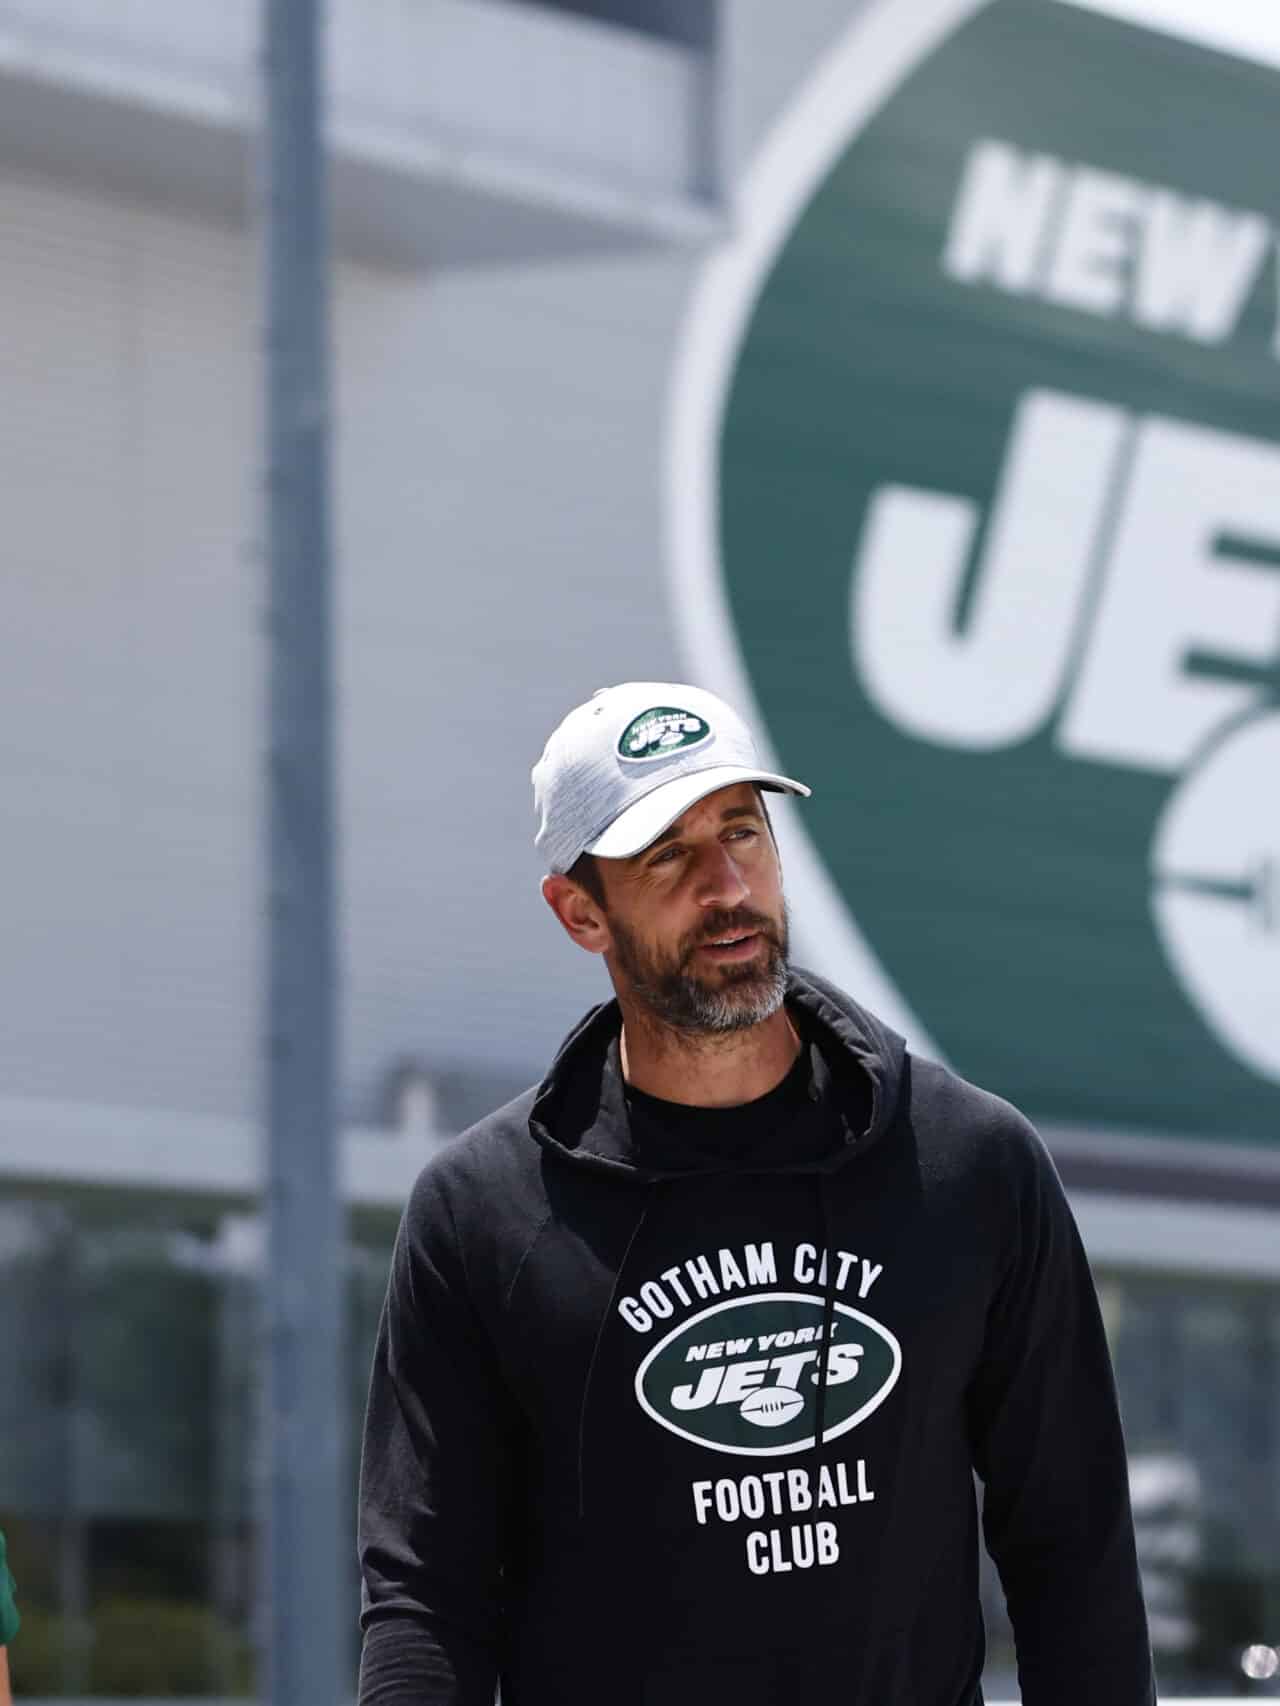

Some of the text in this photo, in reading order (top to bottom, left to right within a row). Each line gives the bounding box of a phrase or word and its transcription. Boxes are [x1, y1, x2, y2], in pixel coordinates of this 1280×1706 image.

[944, 140, 1271, 344] NEW
[617, 1241, 778, 1333] GOTHAM
[670, 1343, 865, 1411] JETS
[686, 1337, 754, 1362] NEW
[692, 1459, 875, 1525] FOOTBALL
[746, 1521, 840, 1575] CLUB
